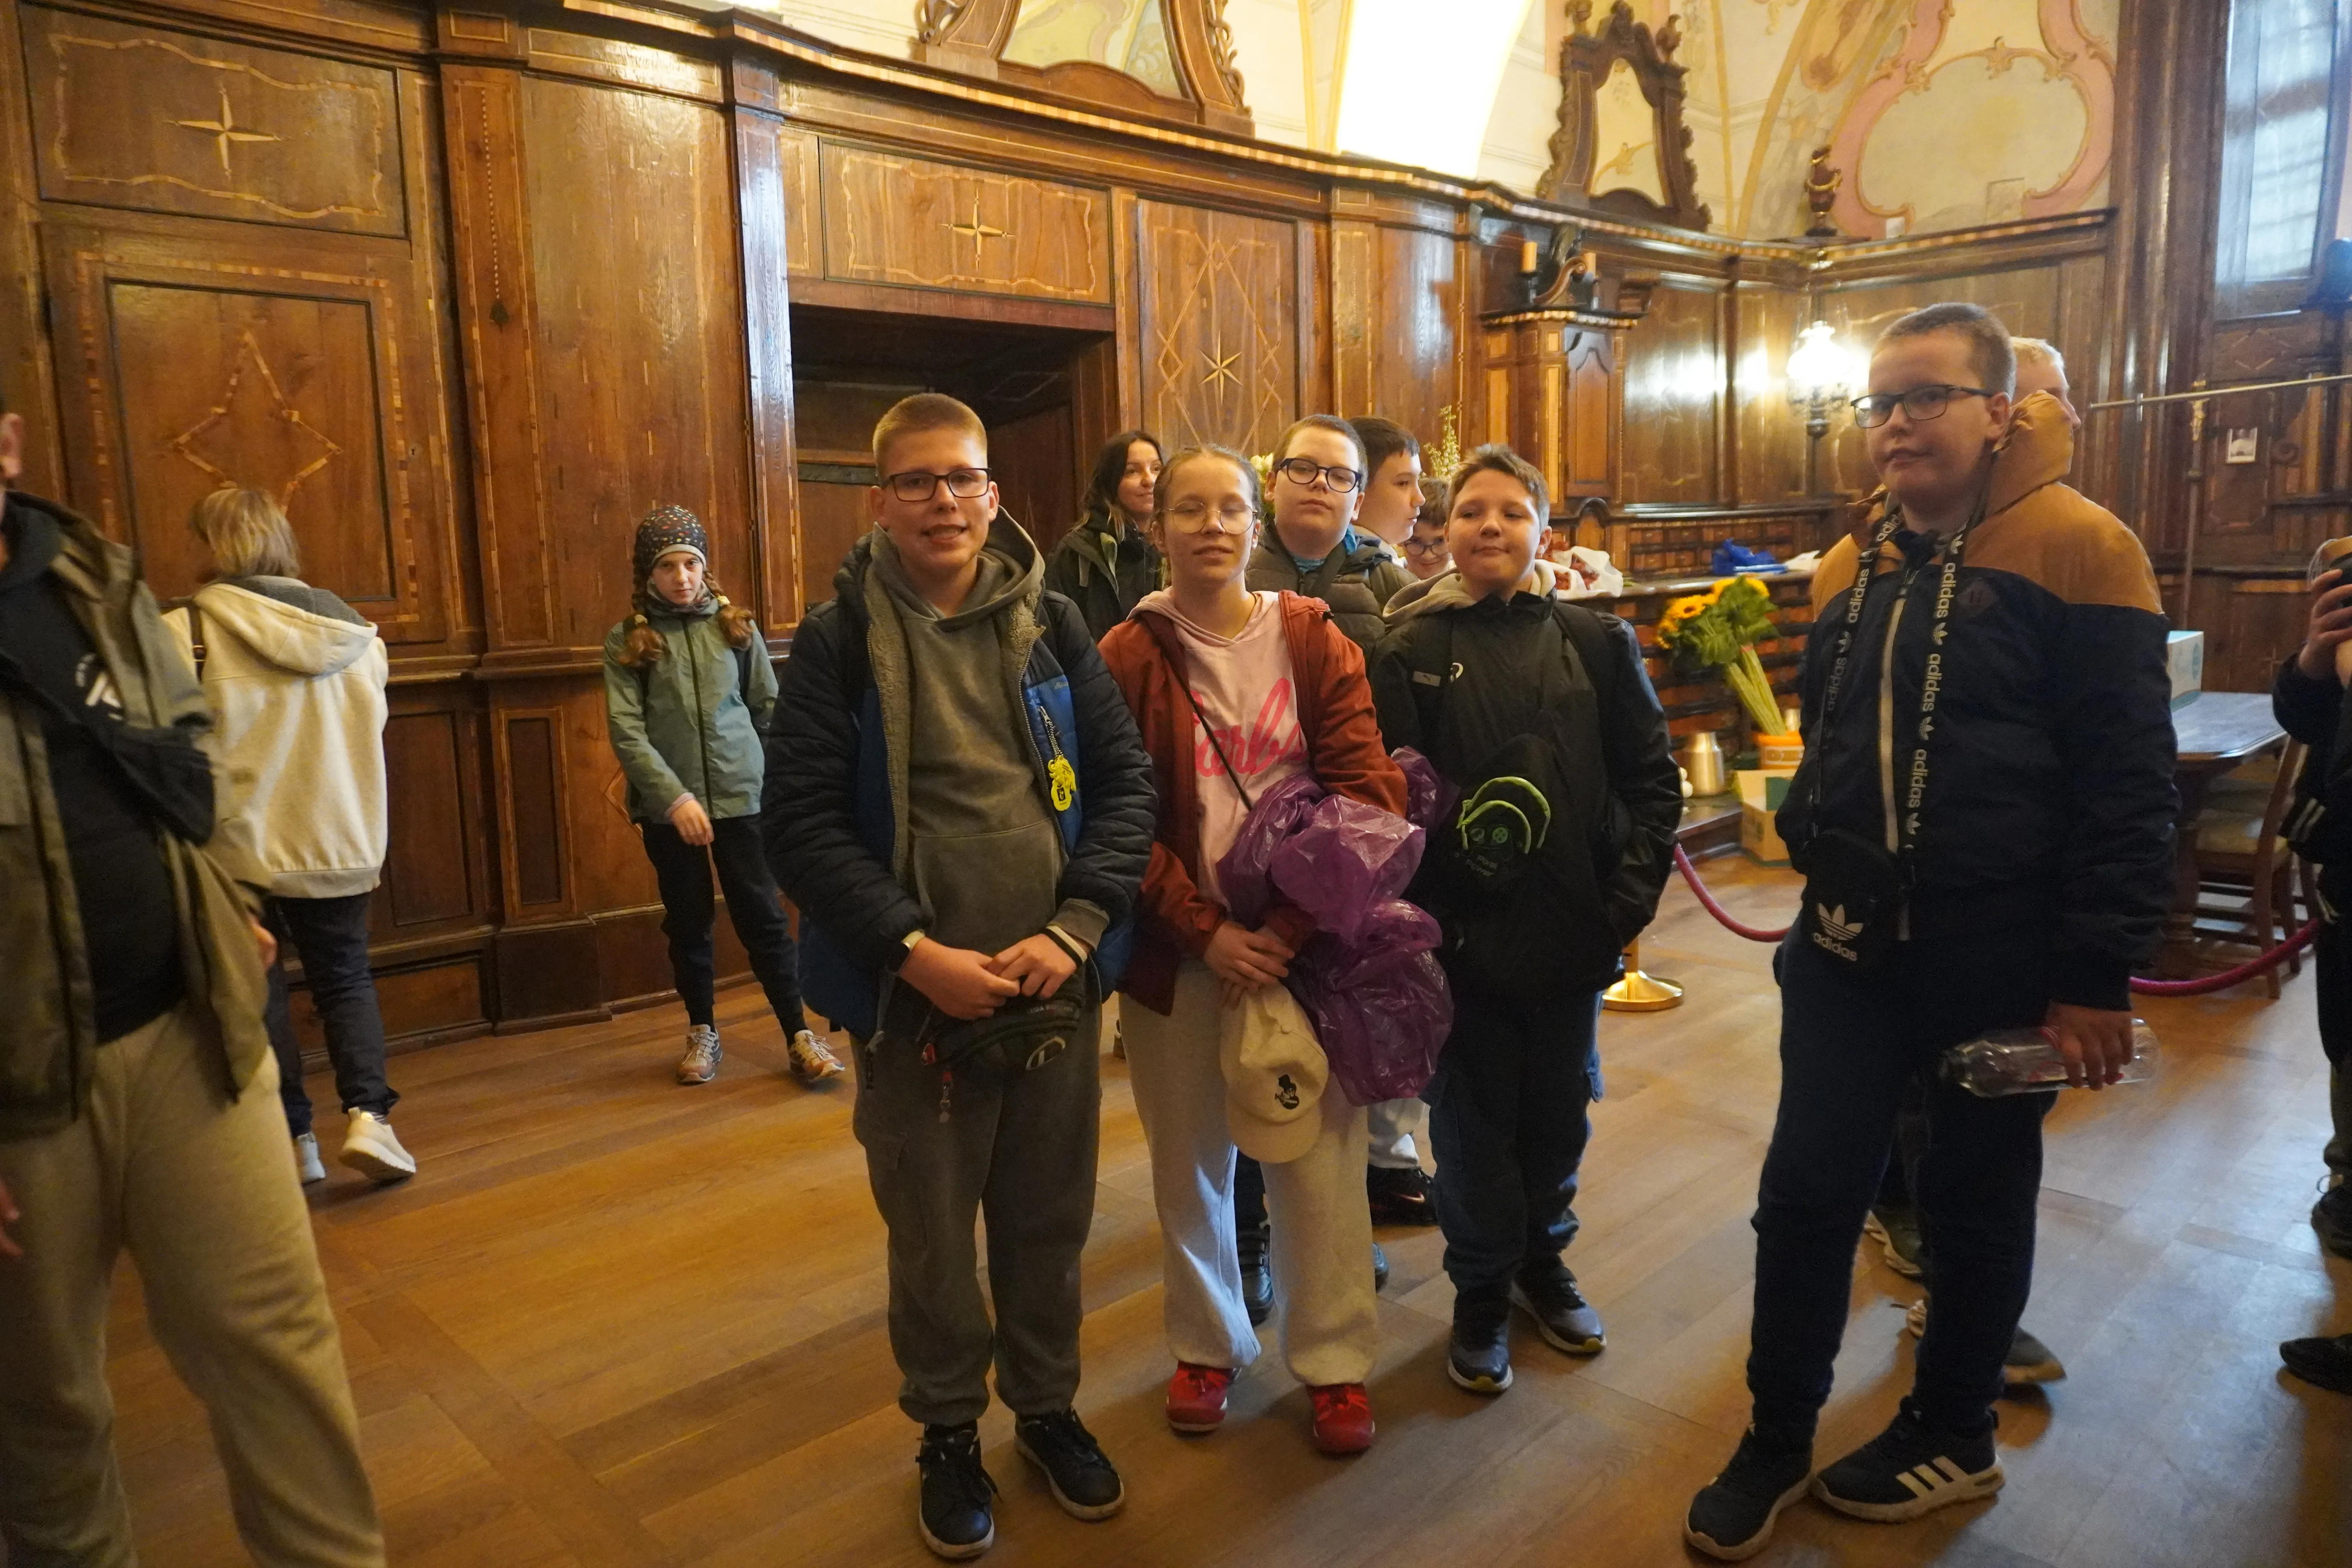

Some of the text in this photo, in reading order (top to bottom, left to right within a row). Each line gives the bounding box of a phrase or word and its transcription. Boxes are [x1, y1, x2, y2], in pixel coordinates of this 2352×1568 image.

[1847, 568, 1869, 624] adidas
[1936, 562, 1956, 619] adidas
[1827, 657, 1847, 711] adidas
[1923, 653, 1942, 712] adidas
[1908, 749, 1929, 808] adidas
[1812, 931, 1858, 962] adidas
